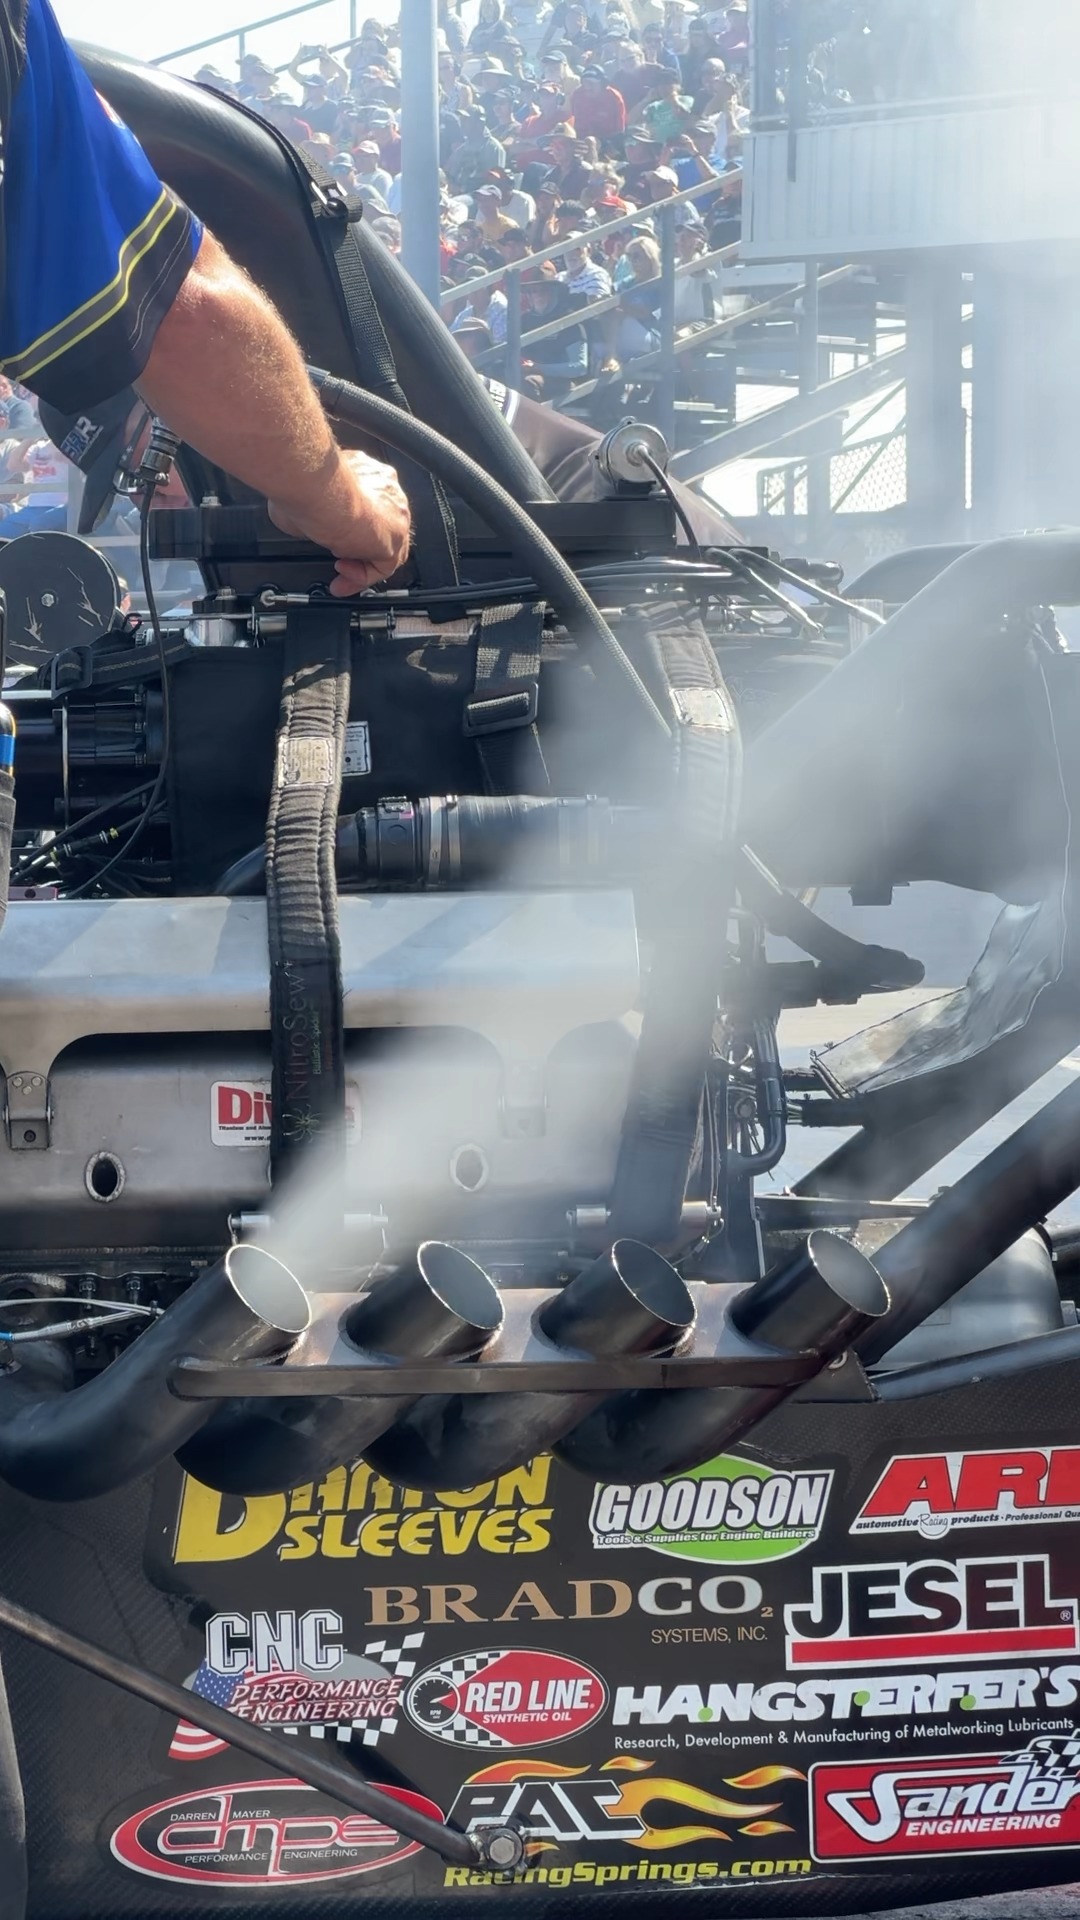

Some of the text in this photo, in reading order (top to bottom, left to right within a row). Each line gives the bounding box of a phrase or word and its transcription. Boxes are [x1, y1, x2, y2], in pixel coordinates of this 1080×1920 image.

[594, 1475, 828, 1533] GOODSON
[278, 1506, 555, 1562] SLEEVES
[856, 1519, 918, 1530] automotive
[919, 1513, 949, 1532] Racing
[951, 1513, 999, 1526] products
[1005, 1510, 1062, 1522] Professional
[598, 1529, 815, 1545] Tools & Supplies for Engine Builders
[206, 1608, 344, 1677] CNC
[650, 1625, 769, 1645] SYSTEMS, INC.
[229, 1678, 404, 1706] PERFORMANCE
[464, 1678, 593, 1713] RED LINE
[612, 1664, 1080, 1726] HANGSTERFER'S
[228, 1699, 398, 1724] ENGINEERING
[482, 1711, 572, 1724] SYNTHETIC OIL
[614, 1716, 1075, 1750] Research, Development & Manufacturing of Metalworking Lubricants
[170, 1809, 271, 1822] DARREN MAYER
[445, 1779, 647, 1841] PAC
[905, 1813, 1062, 1837] ENGINEERING
[184, 1848, 359, 1864] PERFORMANCE ENGINEERING
